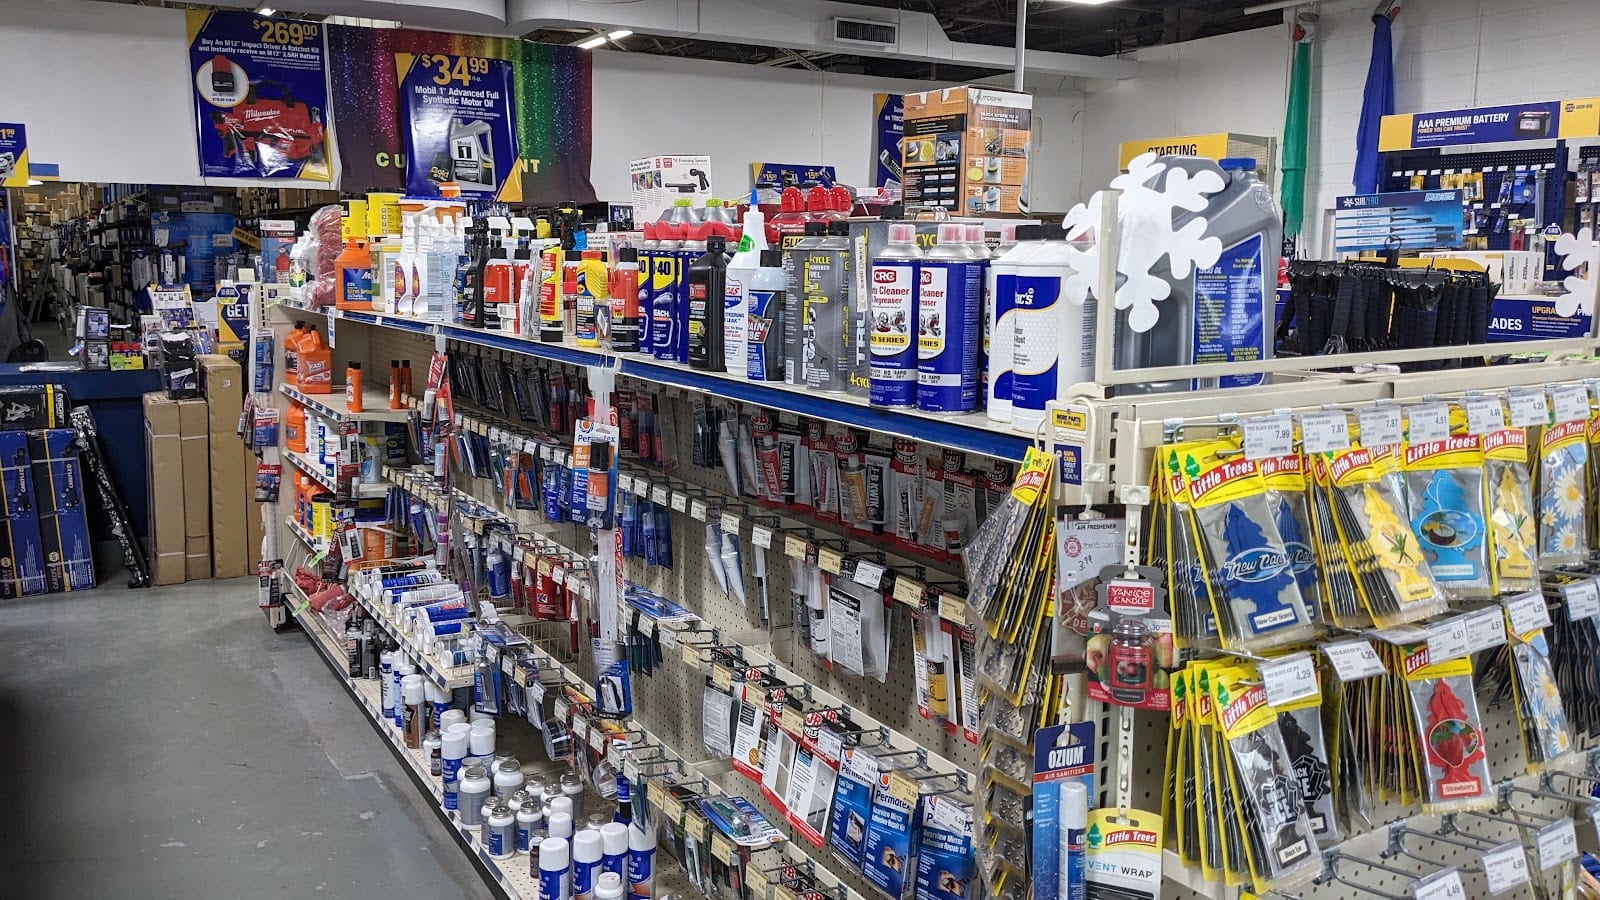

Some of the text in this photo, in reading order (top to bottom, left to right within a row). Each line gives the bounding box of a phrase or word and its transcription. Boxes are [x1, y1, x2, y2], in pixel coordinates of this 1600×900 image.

[211, 46, 236, 54] Instantly
[242, 41, 262, 49] Impact
[263, 42, 281, 50] Driver
[288, 44, 310, 52] Ratchet
[311, 45, 320, 53] Kit
[415, 86, 499, 100] Mobil Advanced Full
[422, 95, 494, 108] Synthetic Motor Oil
[244, 109, 281, 119] Milwaukee
[1418, 112, 1510, 129] AAA PREMIUM BATTERY
[978, 128, 984, 138] 1
[975, 157, 983, 168] 2
[431, 166, 449, 176] Gold
[975, 186, 983, 196] 3
[874, 271, 896, 282] CRC
[879, 286, 910, 296] Cleaner
[1488, 318, 1523, 331] ADES
[878, 334, 905, 344] SERIES
[1068, 415, 1082, 423] PARTS
[1275, 429, 1290, 440] 7.99
[1543, 421, 1585, 446] Little Trees
[1483, 430, 1523, 451] Little Trees
[1407, 435, 1477, 464] Little Trees
[781, 457, 790, 481] WELD
[1276, 457, 1299, 470] Trees
[1331, 450, 1369, 479] Little Trees
[1016, 473, 1043, 487] Little Trees
[1191, 460, 1254, 499] Little Trees
[870, 483, 881, 508] KWIK
[1224, 558, 1258, 581] New
[1268, 614, 1278, 623] Car
[1278, 611, 1293, 621] Scent
[1490, 620, 1503, 632] 4.51
[1452, 628, 1465, 640] 4.51
[1360, 650, 1376, 660] 4.29
[1296, 669, 1312, 682] 4.29
[1224, 687, 1267, 729] Little Trees
[1048, 746, 1084, 769] OZIUM
[1045, 768, 1086, 780] AIR SANITIZER
[1445, 784, 1476, 793] Strawberry
[875, 791, 911, 811] Permatex
[871, 806, 904, 822] Rearview Mirror
[871, 814, 887, 826] Adhesive
[887, 818, 898, 829] Repair
[923, 829, 963, 845] Rearview Mirror
[1106, 831, 1156, 844] Little Trees
[922, 838, 967, 855] Adhesive Repair Kit
[1284, 845, 1303, 859] Black Ice
[1087, 860, 1153, 879] VENT WRAP
[1512, 859, 1525, 870] 4.99
[1446, 883, 1460, 897] 4.49
